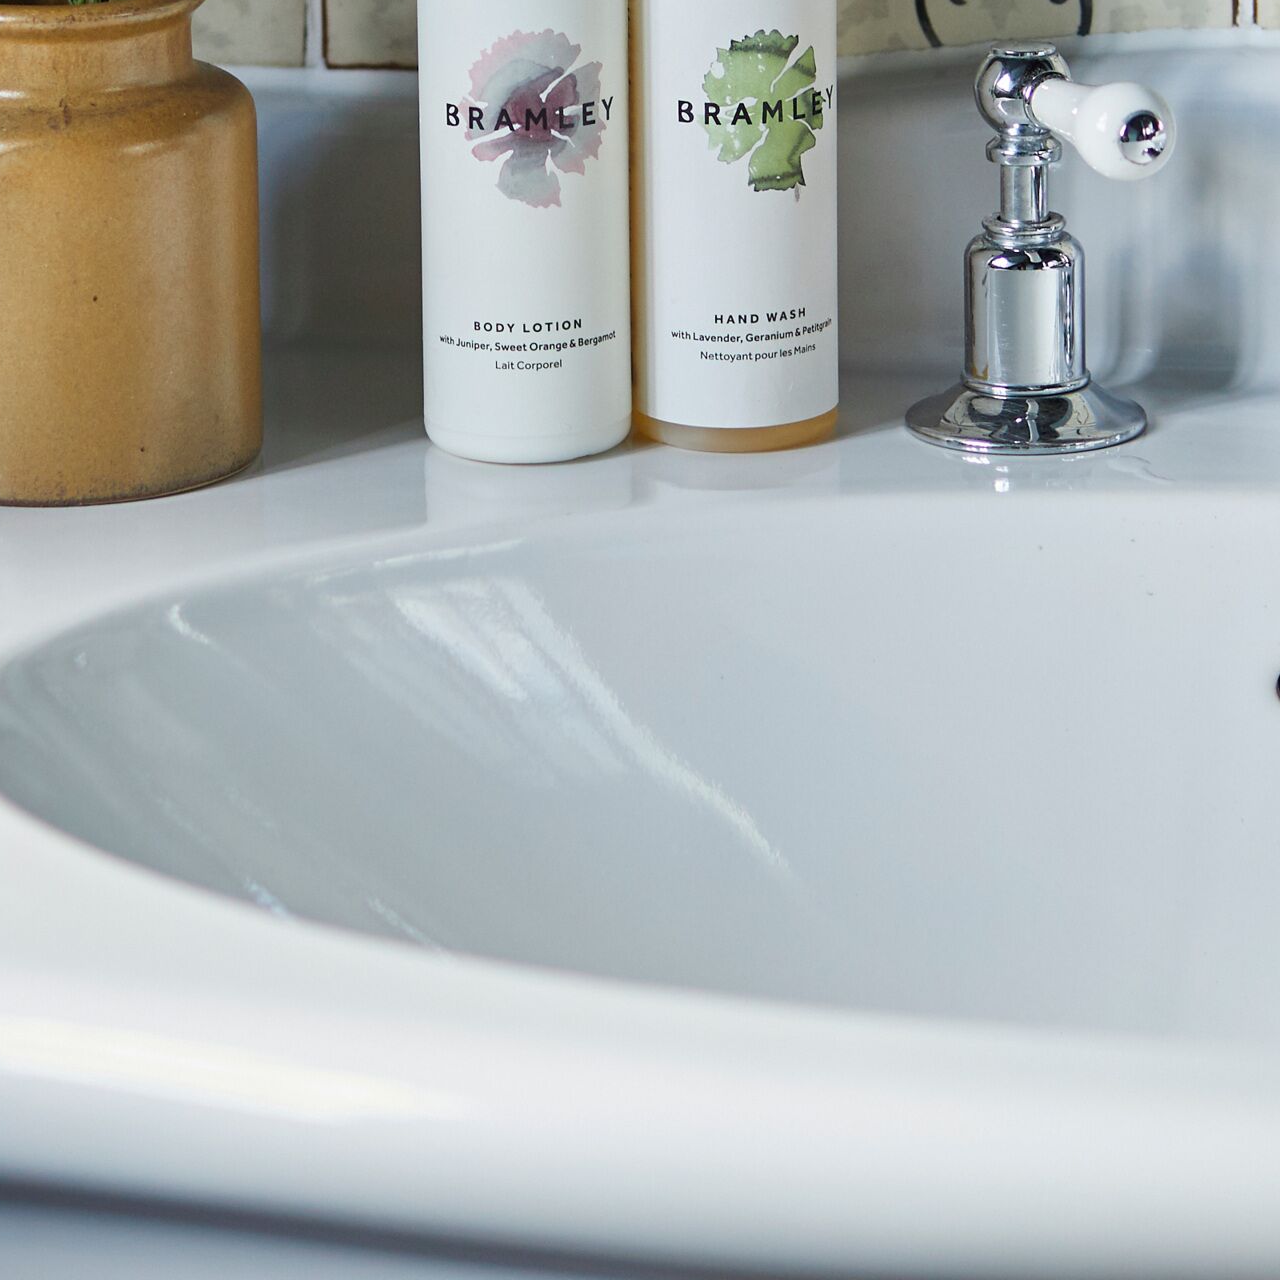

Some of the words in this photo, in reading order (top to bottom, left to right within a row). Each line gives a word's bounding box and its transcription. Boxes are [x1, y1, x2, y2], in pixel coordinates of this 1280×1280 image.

[446, 96, 614, 131] BRAMLEY
[677, 85, 833, 126] BRAMLEY
[714, 314, 759, 324] HAND
[766, 307, 806, 322] WASH
[474, 321, 515, 332] BODY
[522, 318, 582, 332] LOTION
[439, 334, 455, 345] with
[456, 339, 492, 352] Juniper,
[494, 342, 527, 351] Sweet
[529, 341, 568, 352] Orange
[569, 339, 576, 348] &
[578, 330, 616, 347] Bergamot
[671, 330, 691, 340] with
[693, 332, 743, 343] Lavender,
[745, 330, 794, 342] Geranium
[795, 328, 801, 337] &
[700, 351, 753, 363] Nettoyant
[754, 352, 778, 361] pour
[780, 348, 793, 357] les
[794, 343, 816, 355] Mains
[495, 360, 515, 370] Lait
[517, 359, 562, 371] Corporel
